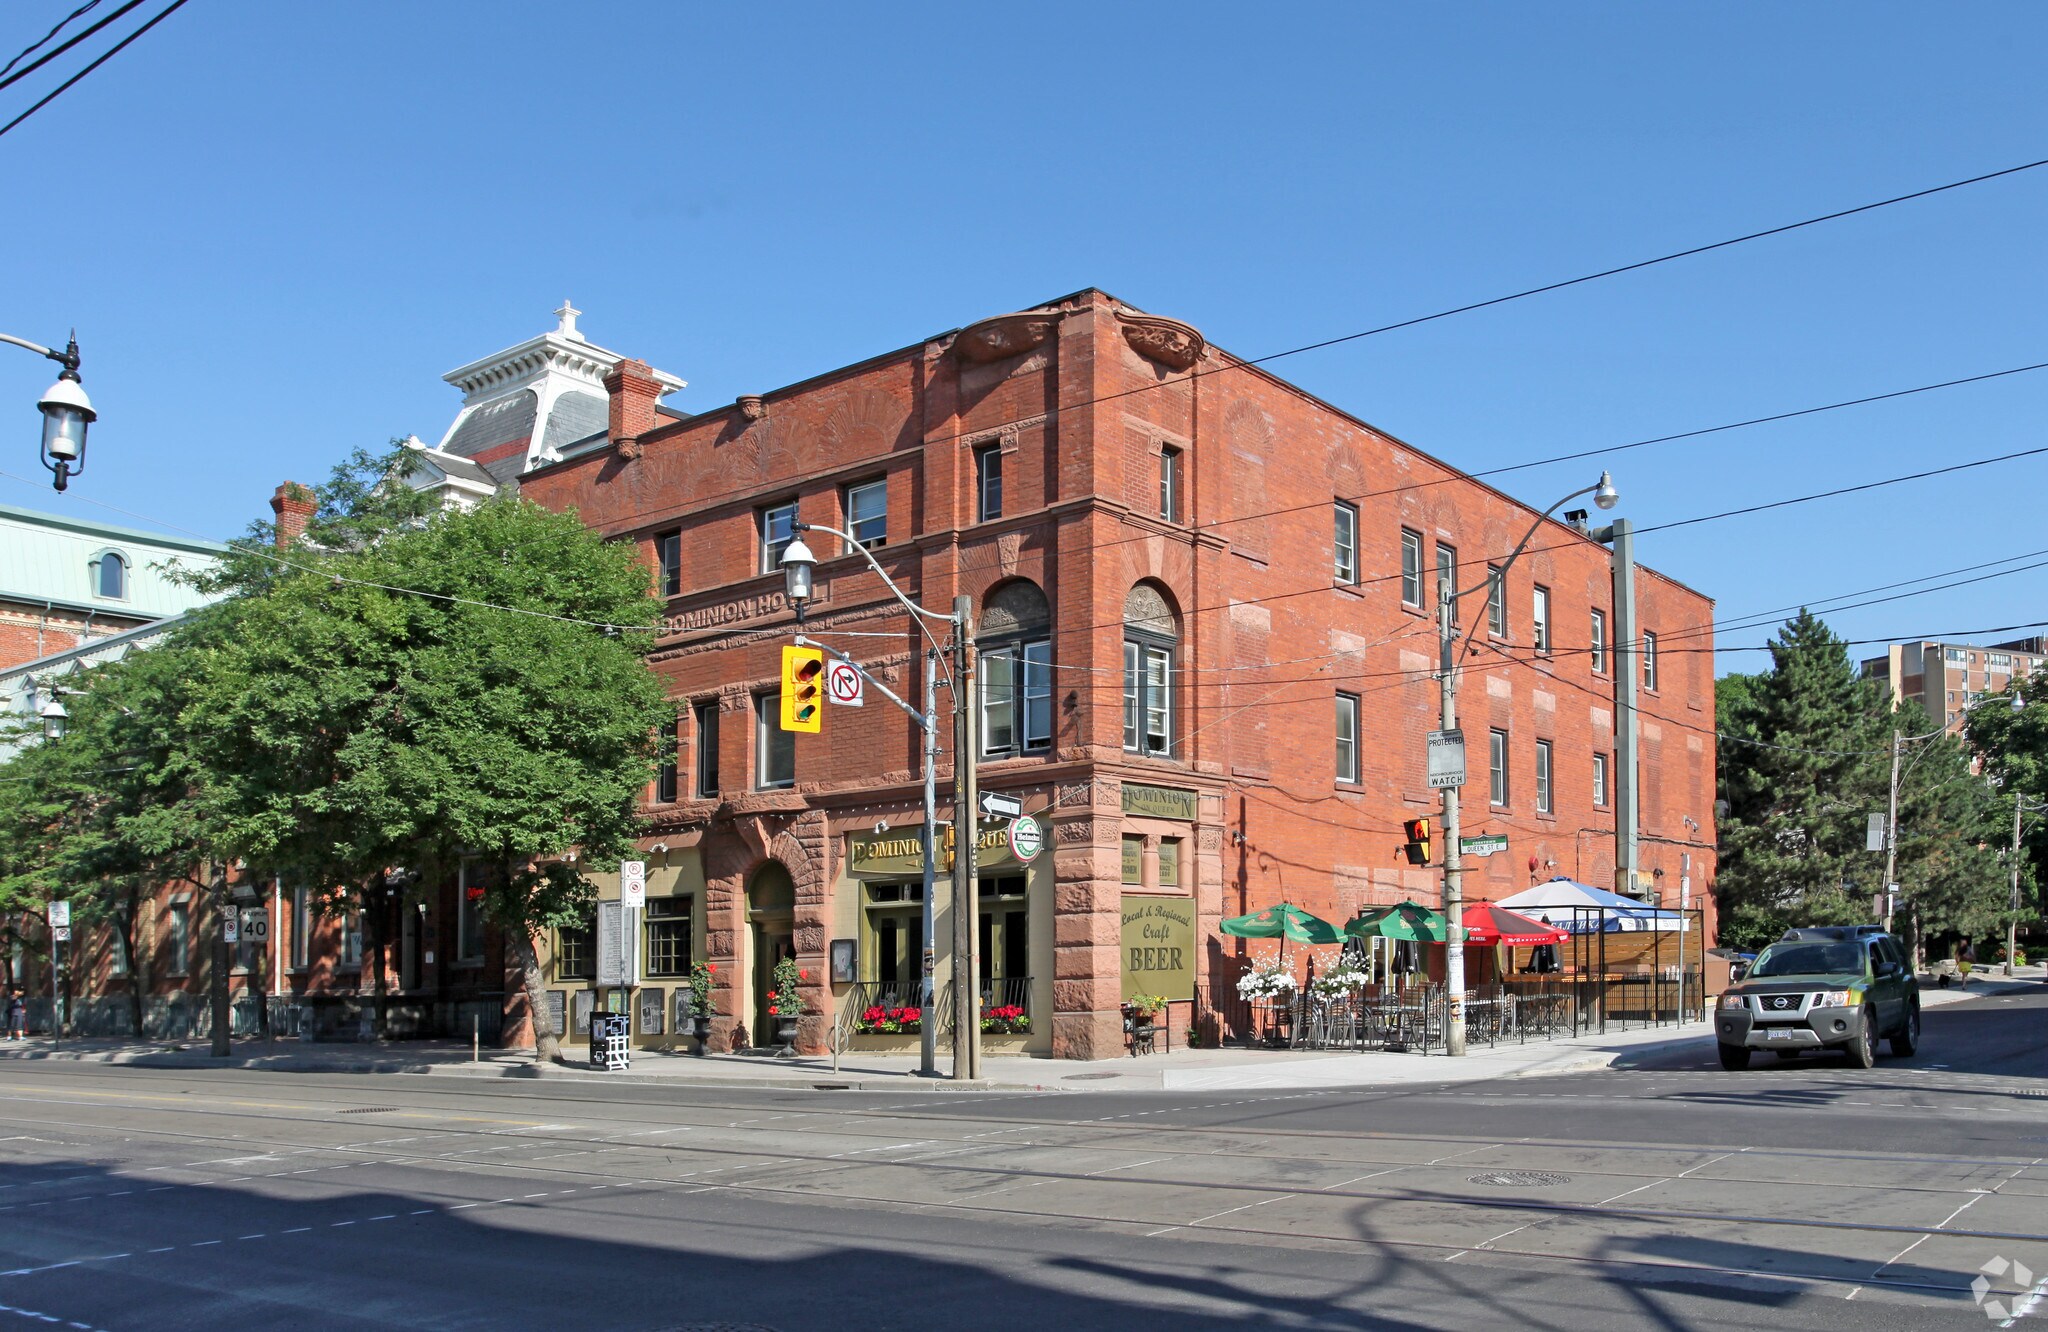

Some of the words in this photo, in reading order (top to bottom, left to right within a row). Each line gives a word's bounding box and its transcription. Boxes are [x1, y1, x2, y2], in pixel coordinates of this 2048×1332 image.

[662, 598, 752, 636] DOMINION
[1428, 736, 1464, 747] PROTECTED
[1431, 776, 1463, 786] WATCH
[1121, 786, 1192, 817] DOMINION
[1152, 805, 1175, 814] QUEEN
[1467, 845, 1485, 853] QUEEN
[1121, 907, 1144, 926] Local
[1145, 905, 1152, 917] &
[1154, 905, 1191, 927] Regional
[244, 921, 266, 936] 40
[1142, 923, 1170, 943] Craft
[1129, 947, 1183, 971] BEER
